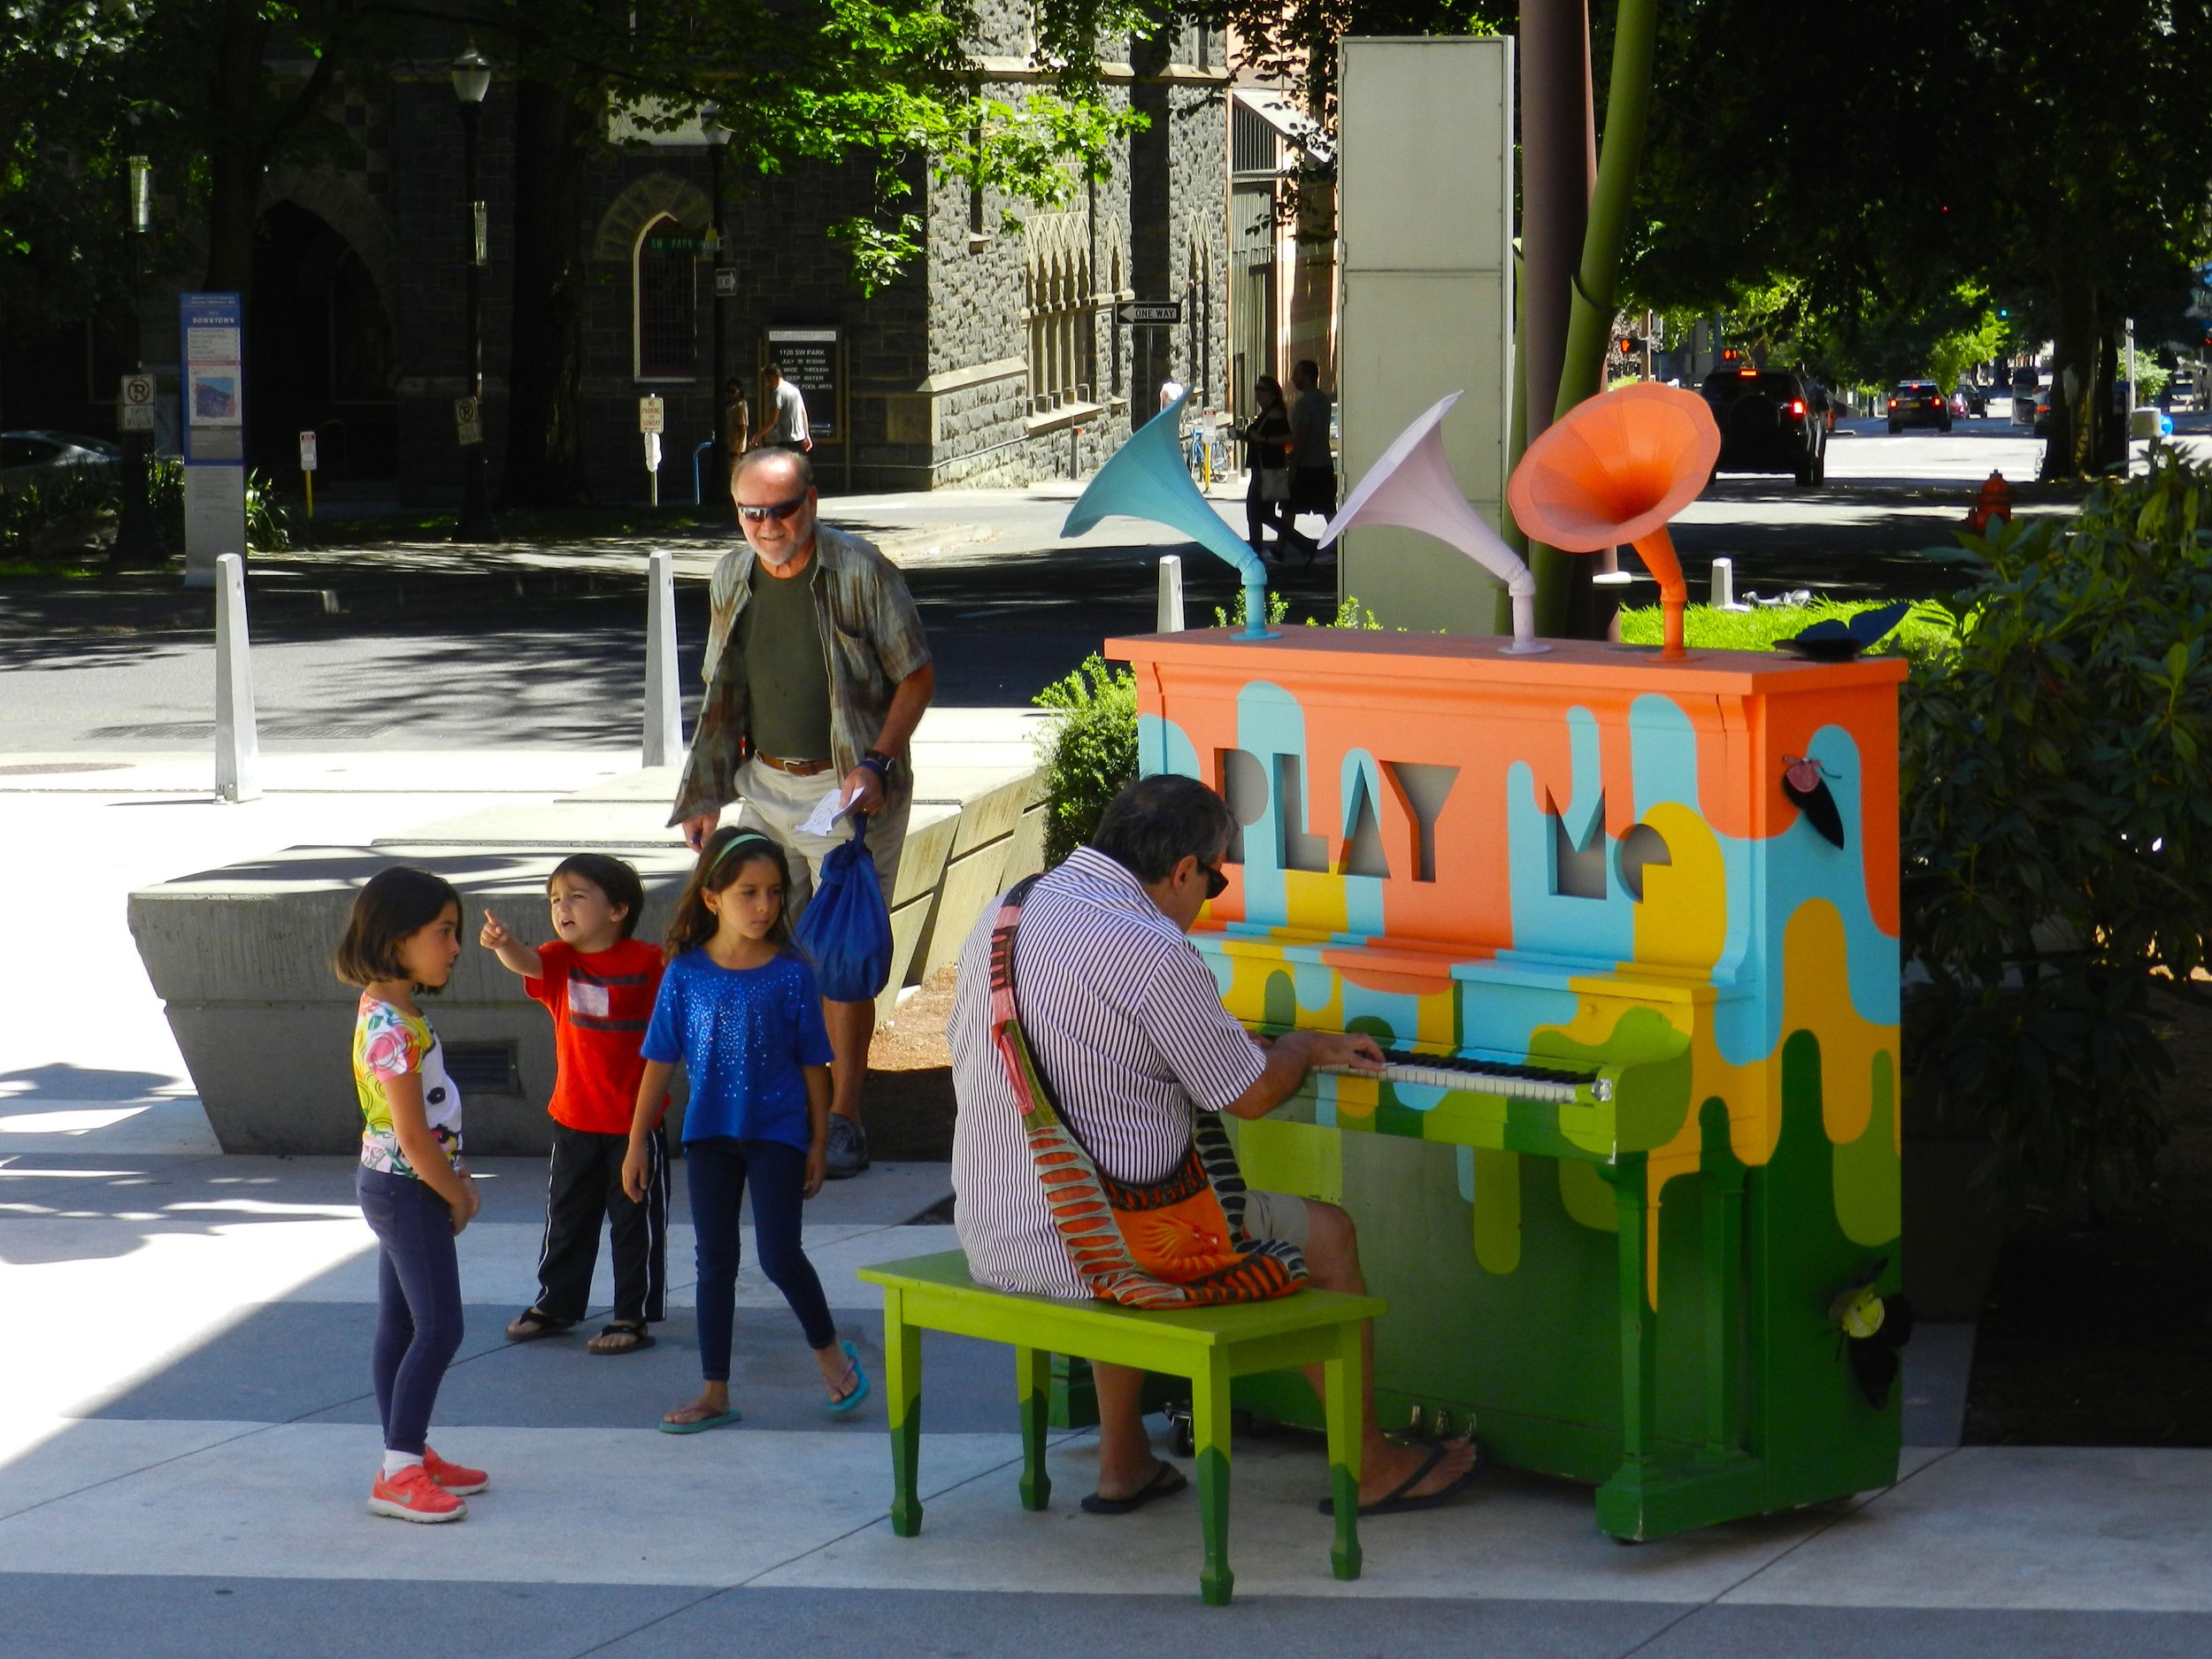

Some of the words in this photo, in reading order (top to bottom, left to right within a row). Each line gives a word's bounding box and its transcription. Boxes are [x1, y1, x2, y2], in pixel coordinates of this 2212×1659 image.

[672, 238, 693, 249] PARK
[1135, 309, 1153, 319] ONE
[1156, 309, 1174, 319] WAY
[1214, 748, 1462, 884] PLAY
